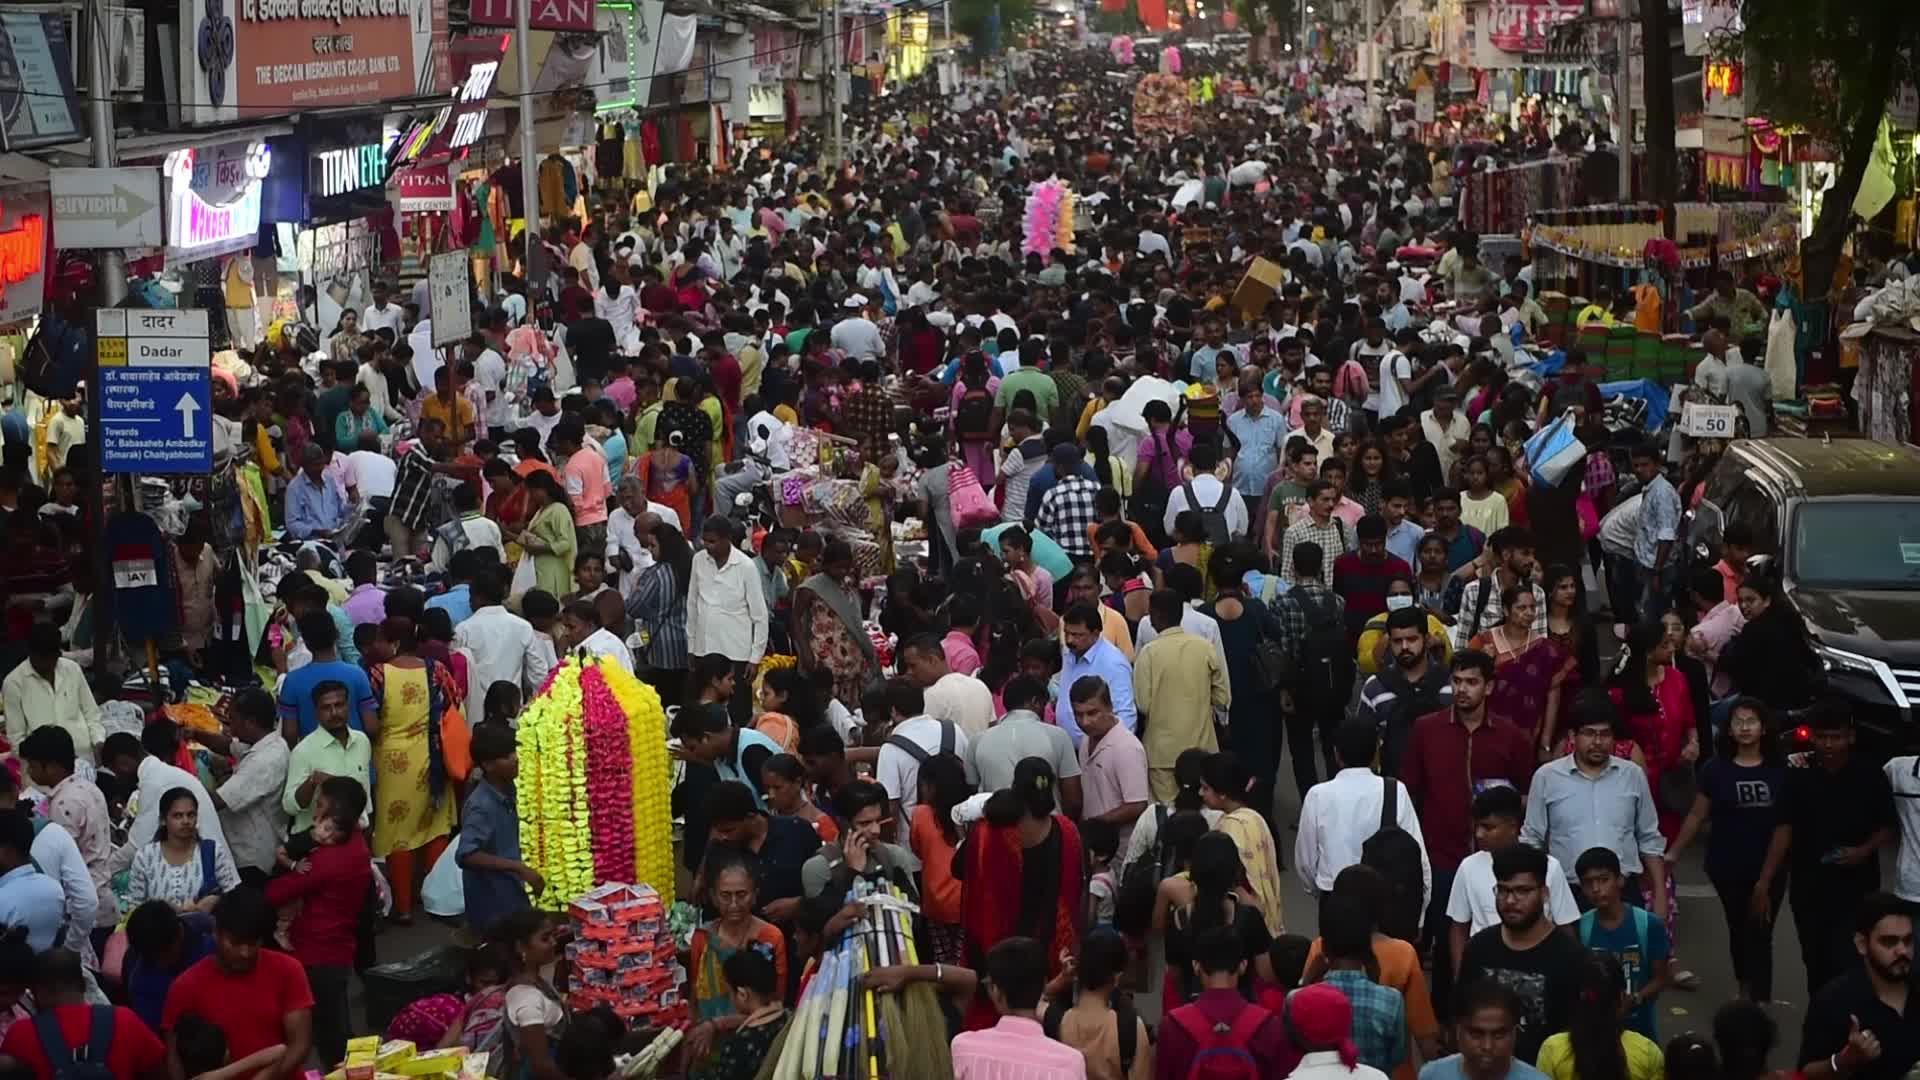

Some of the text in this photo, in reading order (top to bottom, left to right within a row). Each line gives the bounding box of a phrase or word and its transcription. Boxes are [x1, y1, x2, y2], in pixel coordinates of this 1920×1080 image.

[256, 66, 272, 85] THE
[273, 64, 304, 83] DECCAN
[305, 60, 346, 80] MERCHANTS
[369, 57, 387, 74] BANK
[319, 149, 360, 197] TITAN
[400, 175, 446, 187] TITAN
[56, 196, 128, 213] SUVIDHA
[140, 315, 176, 330] दादर
[140, 345, 183, 358] Dadar
[105, 427, 139, 436] Towards
[1706, 418, 1726, 432] 50
[105, 439, 206, 448] Dr. Babasaheb Ambedkar
[105, 450, 142, 460] (Smarak)
